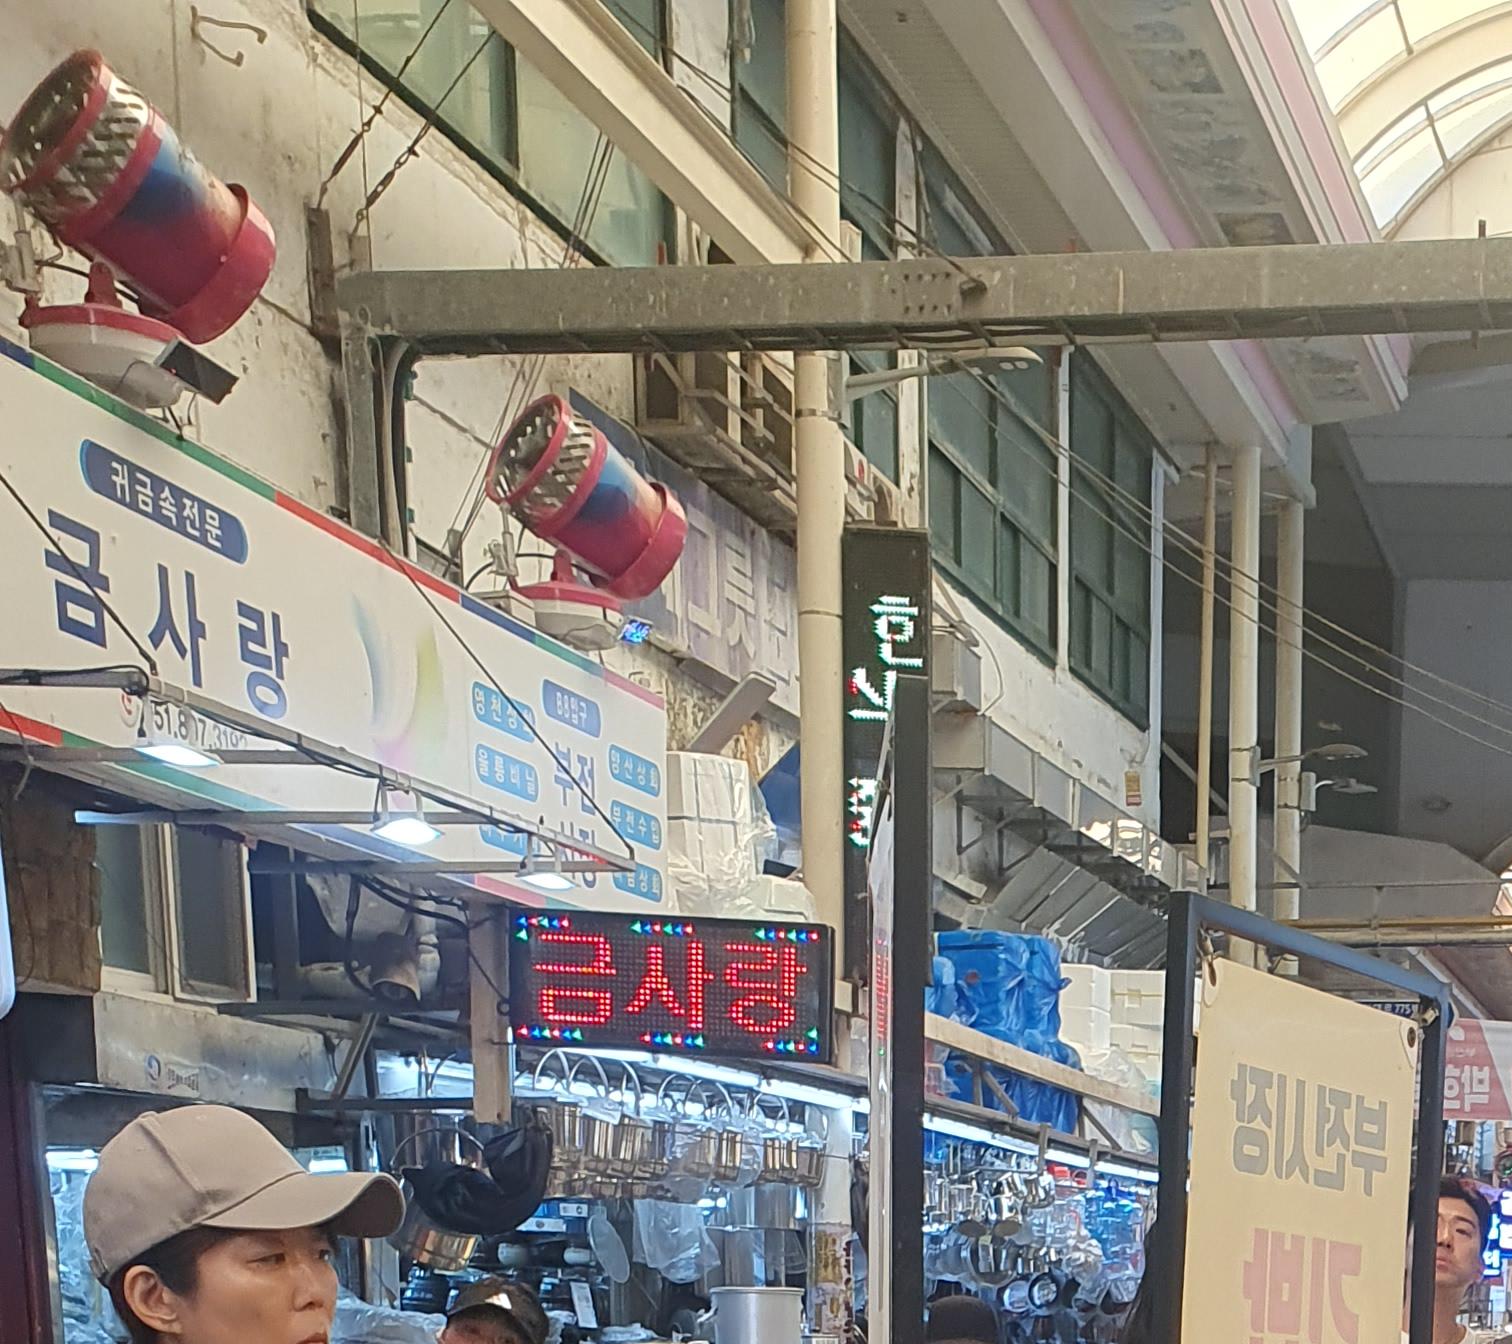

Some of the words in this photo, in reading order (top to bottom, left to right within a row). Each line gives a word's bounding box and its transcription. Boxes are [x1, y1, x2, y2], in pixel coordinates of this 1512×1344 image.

[111, 461, 222, 549] 귀금속전문
[44, 509, 289, 719] 금사랑
[534, 933, 807, 1034] 금사랑
